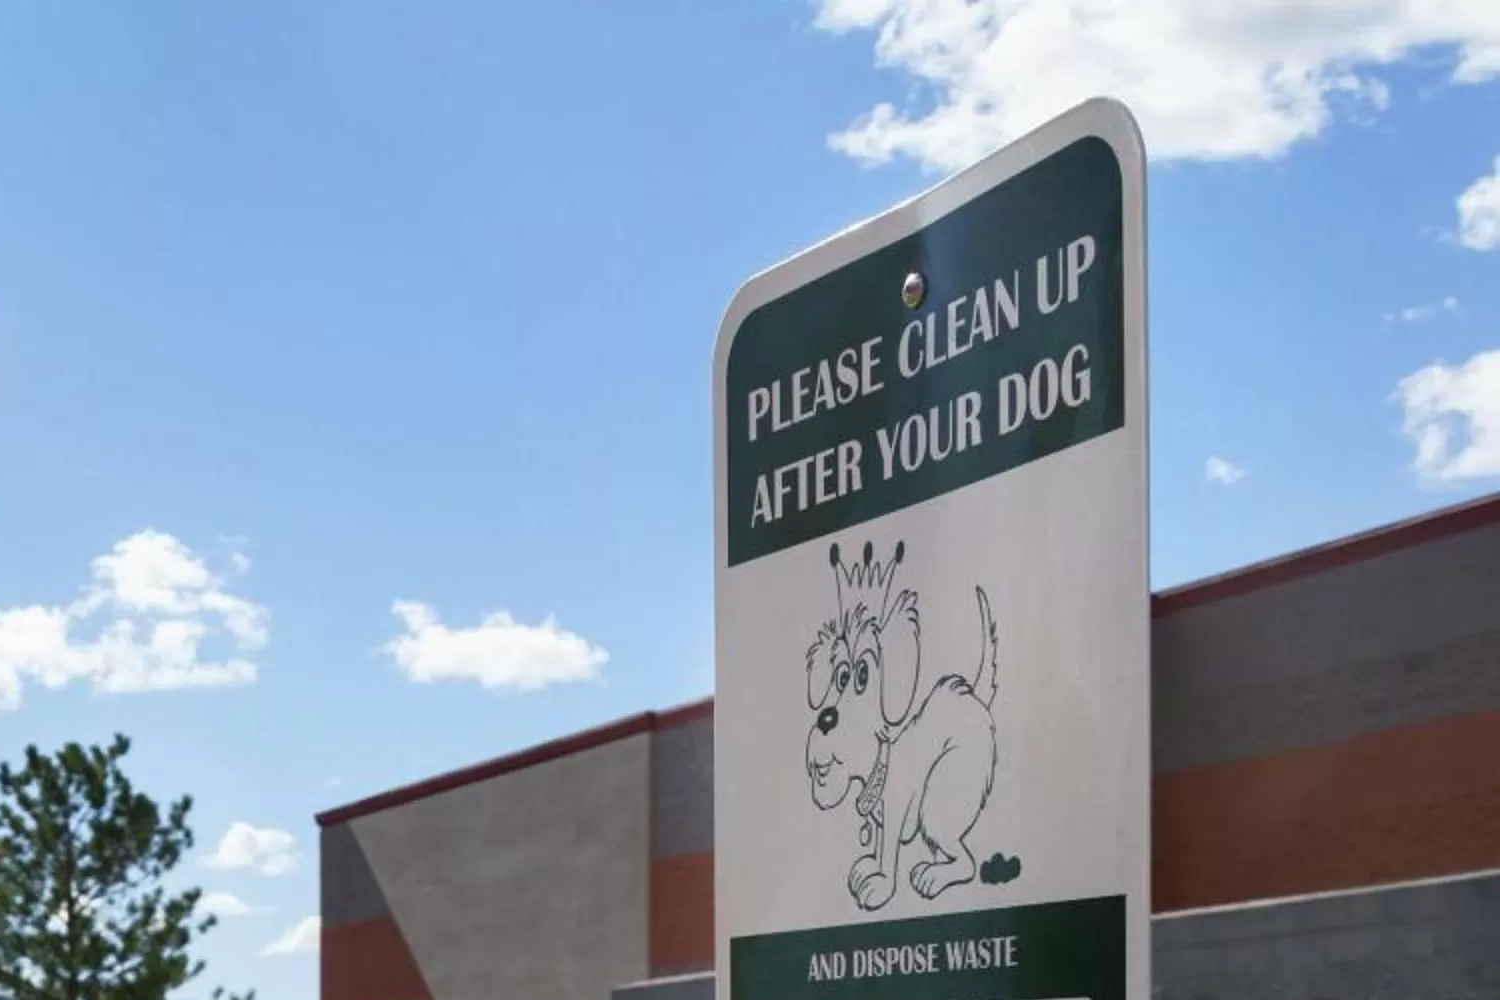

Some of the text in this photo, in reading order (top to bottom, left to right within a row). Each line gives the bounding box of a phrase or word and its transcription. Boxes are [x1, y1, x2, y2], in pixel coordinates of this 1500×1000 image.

[747, 234, 1096, 443] PLEASE CLEAN UP
[750, 342, 1092, 529] AFTER YOUR DOG
[807, 936, 1018, 982] AND DISPOSE WASTE
